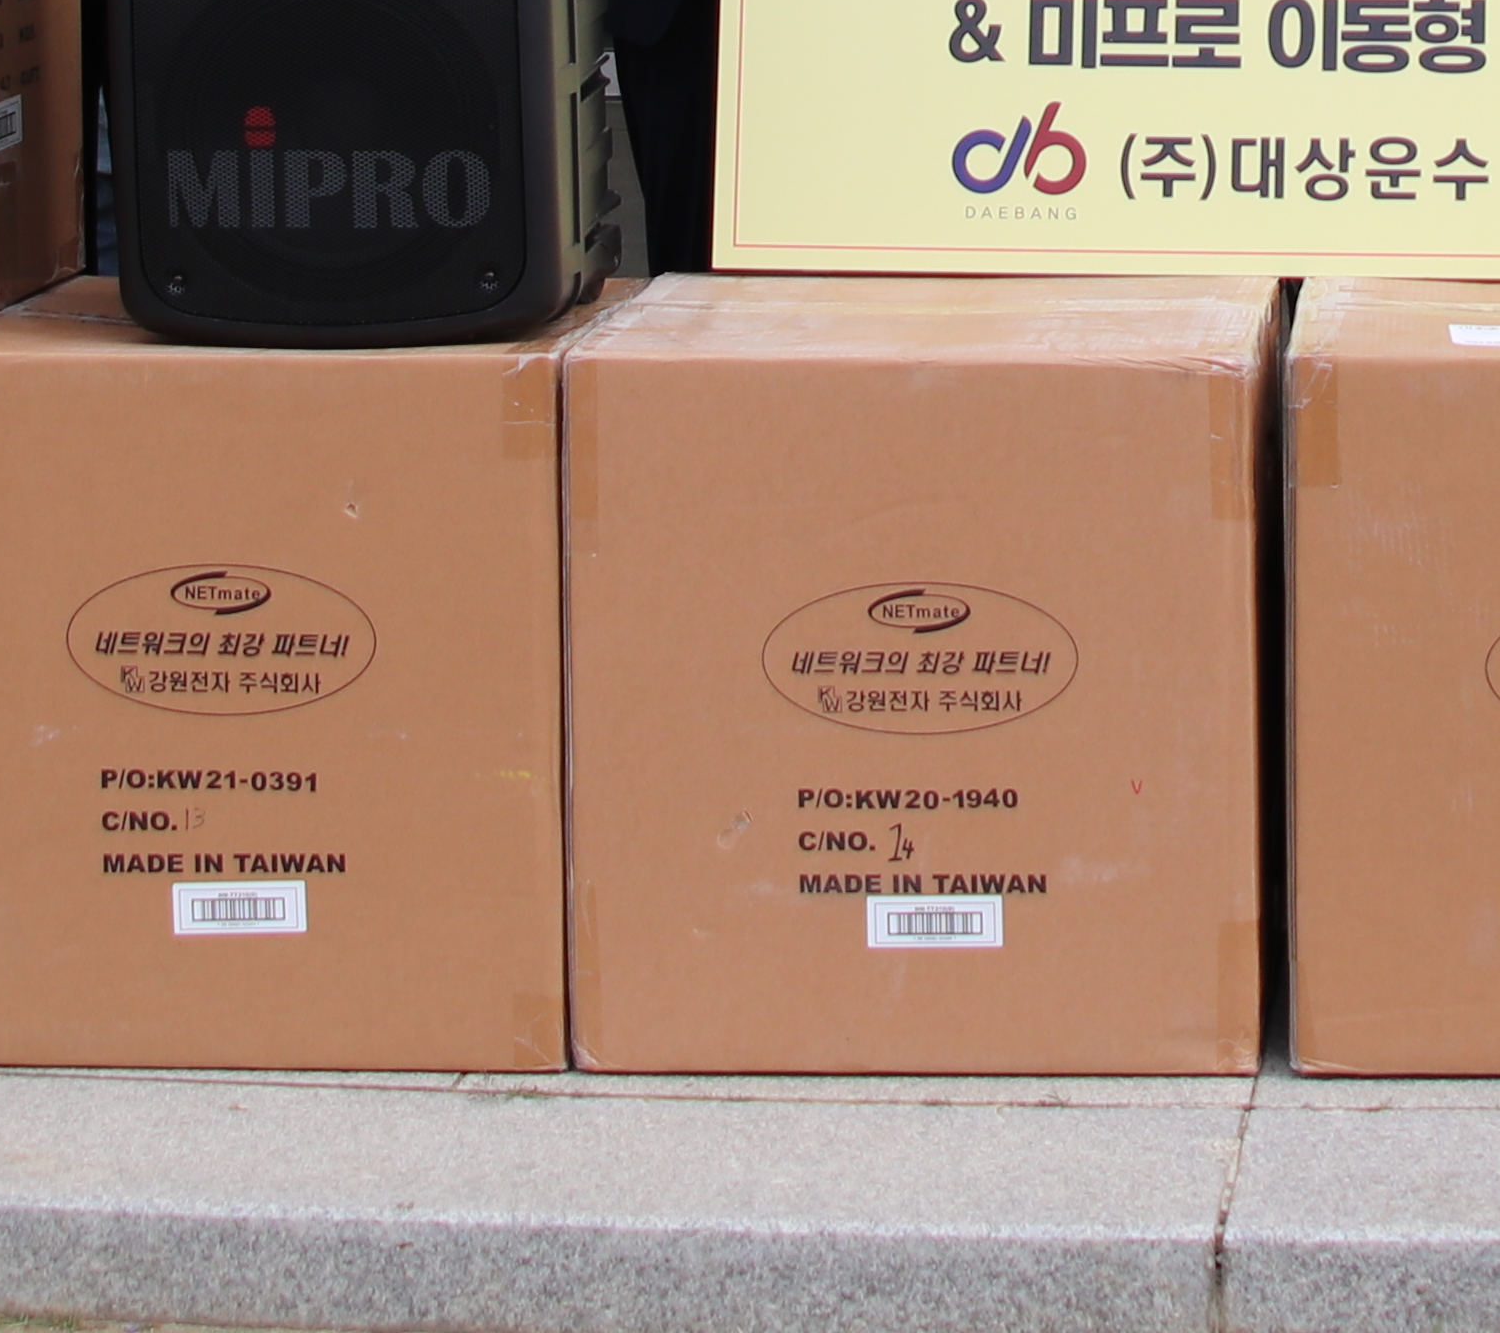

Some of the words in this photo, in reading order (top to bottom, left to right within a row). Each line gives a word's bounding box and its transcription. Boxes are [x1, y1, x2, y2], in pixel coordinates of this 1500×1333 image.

[1120, 133, 1490, 203] (주)대상운수
[965, 206, 1077, 220] DAEBANG
[182, 585, 263, 600] NETmate
[880, 603, 962, 618] NETmate
[95, 631, 211, 657] 네트워크의
[217, 632, 265, 658] 최강
[271, 633, 350, 658] 파트너!
[791, 651, 909, 675] 네트워크의
[916, 651, 965, 676] 최강
[972, 651, 1051, 675] 파트너!
[149, 670, 231, 694] 강원전자
[239, 672, 321, 695] 주식회사
[846, 690, 930, 713] 강원전자
[938, 690, 1022, 712] 주식회사
[101, 768, 317, 793] P/O:KW21-0391
[798, 788, 1018, 810] P/O:KW20-1940
[101, 811, 178, 832] C/NO.
[184, 807, 206, 831] 13
[798, 831, 876, 852] C/NO.
[888, 823, 914, 861] 14
[103, 854, 184, 874] MADE
[194, 853, 223, 874] IN
[233, 853, 346, 874] TAIWAN
[799, 874, 882, 895] MADE
[892, 874, 922, 895] IN
[932, 874, 1047, 895] TAIWAN
